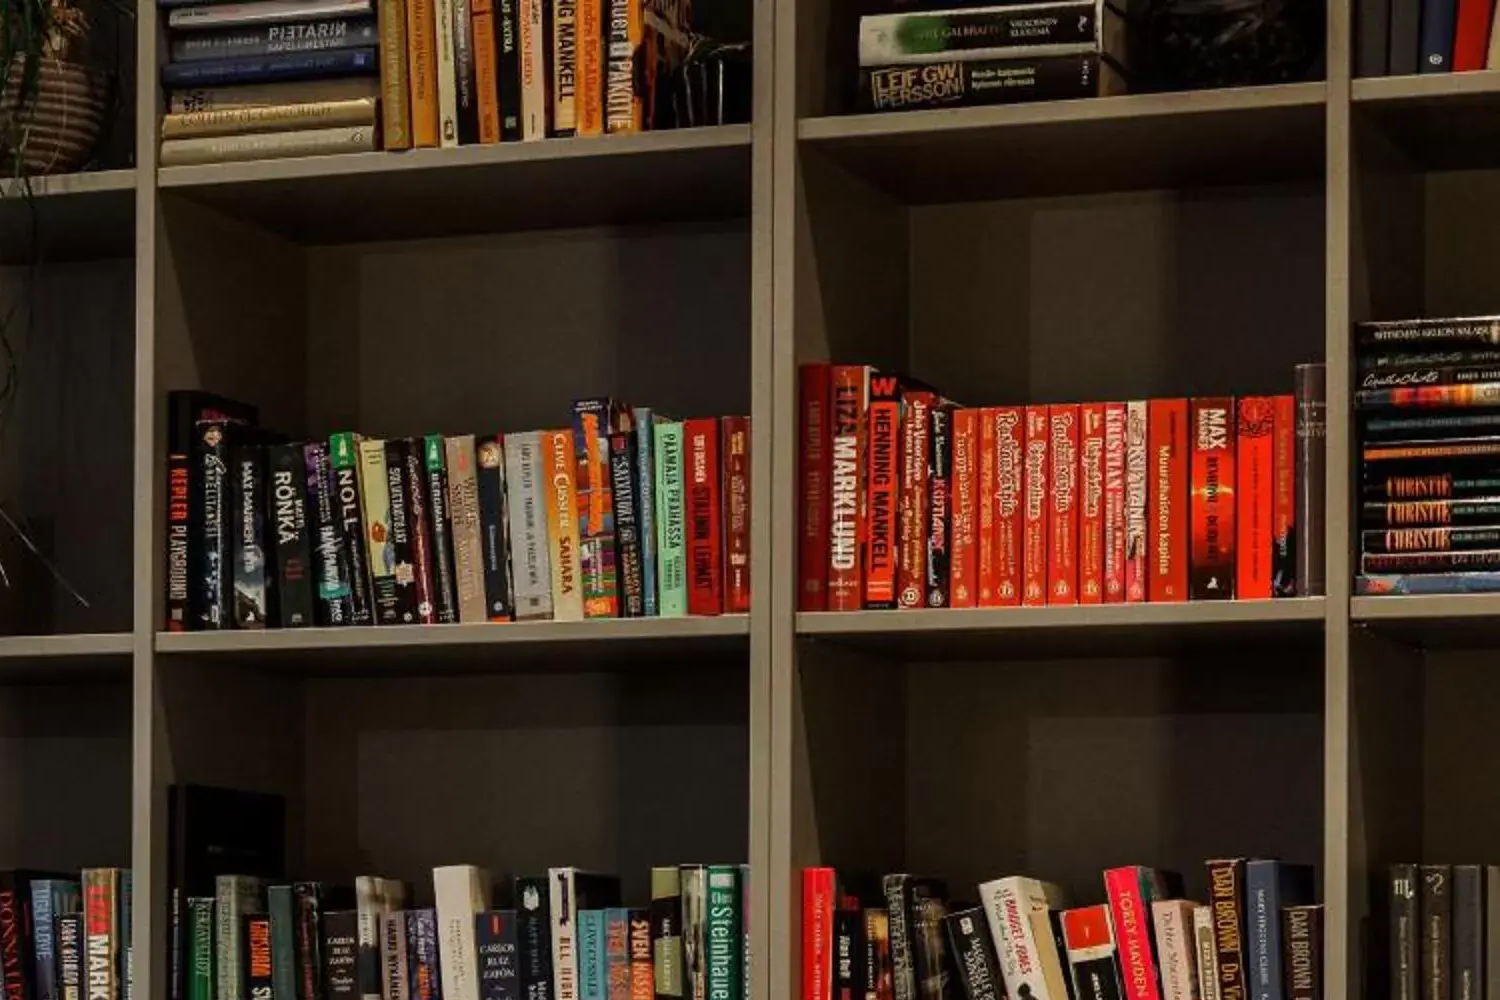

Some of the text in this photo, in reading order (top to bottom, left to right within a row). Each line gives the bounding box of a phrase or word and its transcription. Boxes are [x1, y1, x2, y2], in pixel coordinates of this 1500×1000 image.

[557, 23, 576, 103] MANKELL
[606, 61, 633, 130] PAKOTIE
[1105, 408, 1124, 490] KRISTIAN
[1208, 408, 1227, 450] MAX
[274, 471, 299, 544] RÖNKÄ
[338, 469, 358, 532] NOLL
[431, 472, 443, 532] BERGMAN
[553, 433, 573, 594] CLIVE CUSSLER SAHARA
[831, 436, 857, 570] MARKLUND
[871, 408, 892, 574] HENNING MANKELL
[1157, 445, 1171, 575] Muurahaisten kapina
[1386, 474, 1453, 497] CHRISTIE
[1386, 500, 1453, 525] CHRISTIE
[170, 525, 187, 600] PLAYGROUND
[1385, 528, 1452, 552] CHRISTIE
[33, 889, 52, 925] UGLY
[1212, 866, 1234, 898] DAN
[0, 890, 18, 962] DONNA
[35, 926, 53, 960] LOVE
[631, 920, 652, 959] SVEN
[1118, 891, 1148, 998] TOREY HAYDEN
[1214, 902, 1241, 955] BROWN
[1289, 911, 1307, 938] DAN
[1014, 942, 1032, 975] JONES
[1221, 963, 1238, 983] Da
[1292, 941, 1311, 990] BROWN
